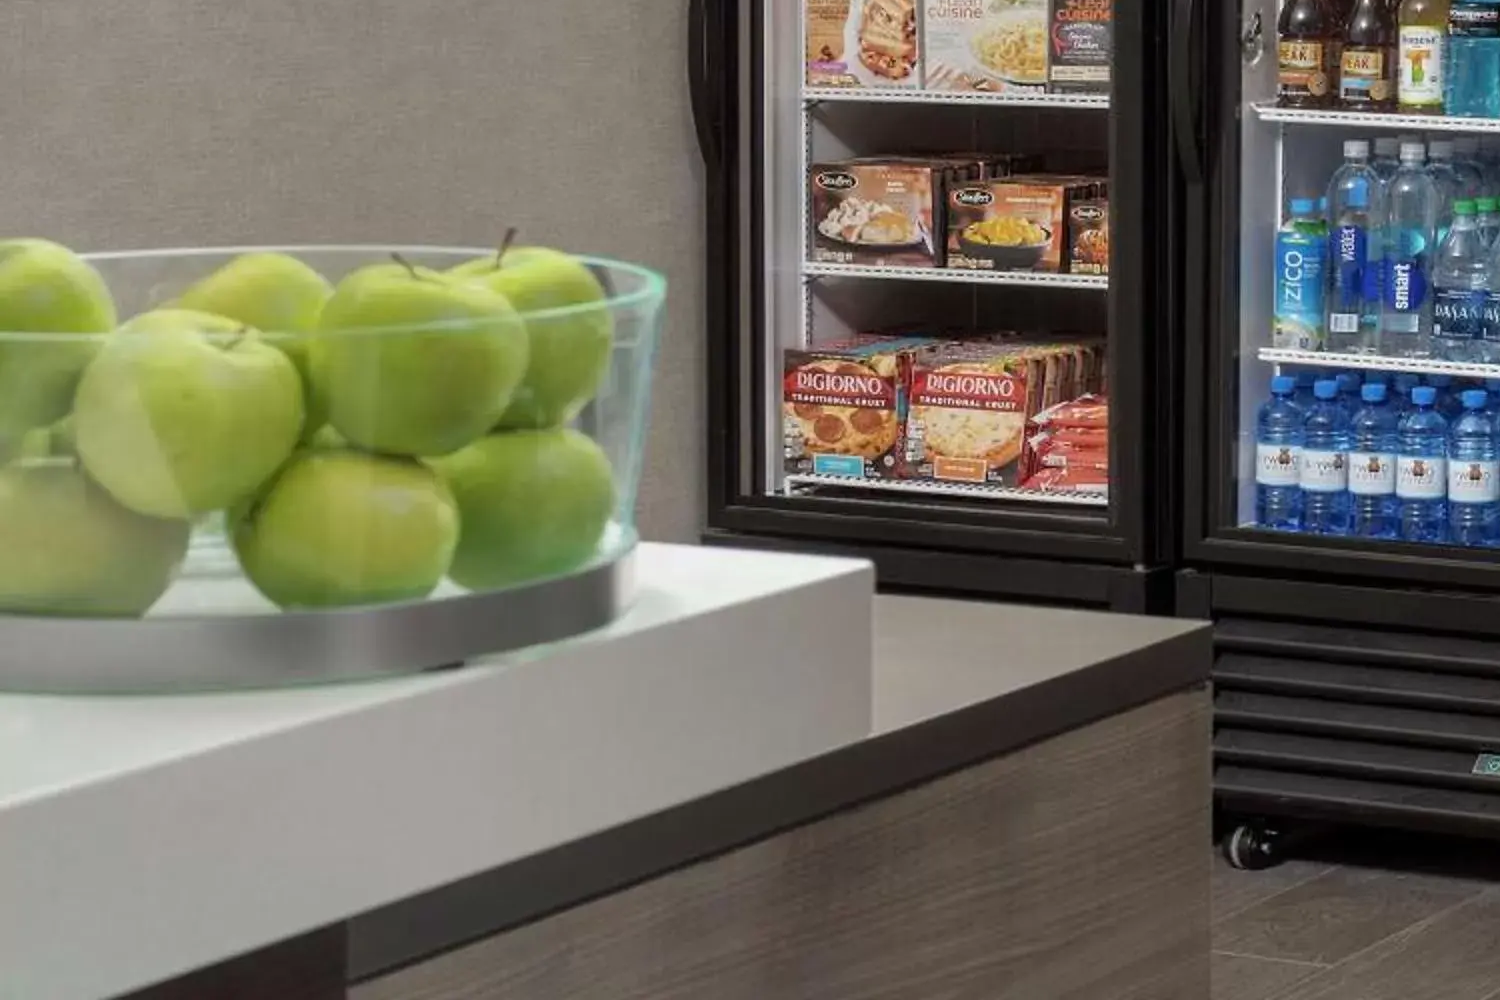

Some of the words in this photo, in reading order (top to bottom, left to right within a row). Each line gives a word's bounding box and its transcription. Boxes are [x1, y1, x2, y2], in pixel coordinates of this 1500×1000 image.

[927, 6, 984, 19] cuisine
[1394, 263, 1410, 310] smart
[797, 371, 883, 396] DIGIORNO
[926, 373, 1014, 397] DIGIORNO
[791, 393, 853, 406] TRADITIONAL
[919, 396, 981, 409] TRADITIONAL
